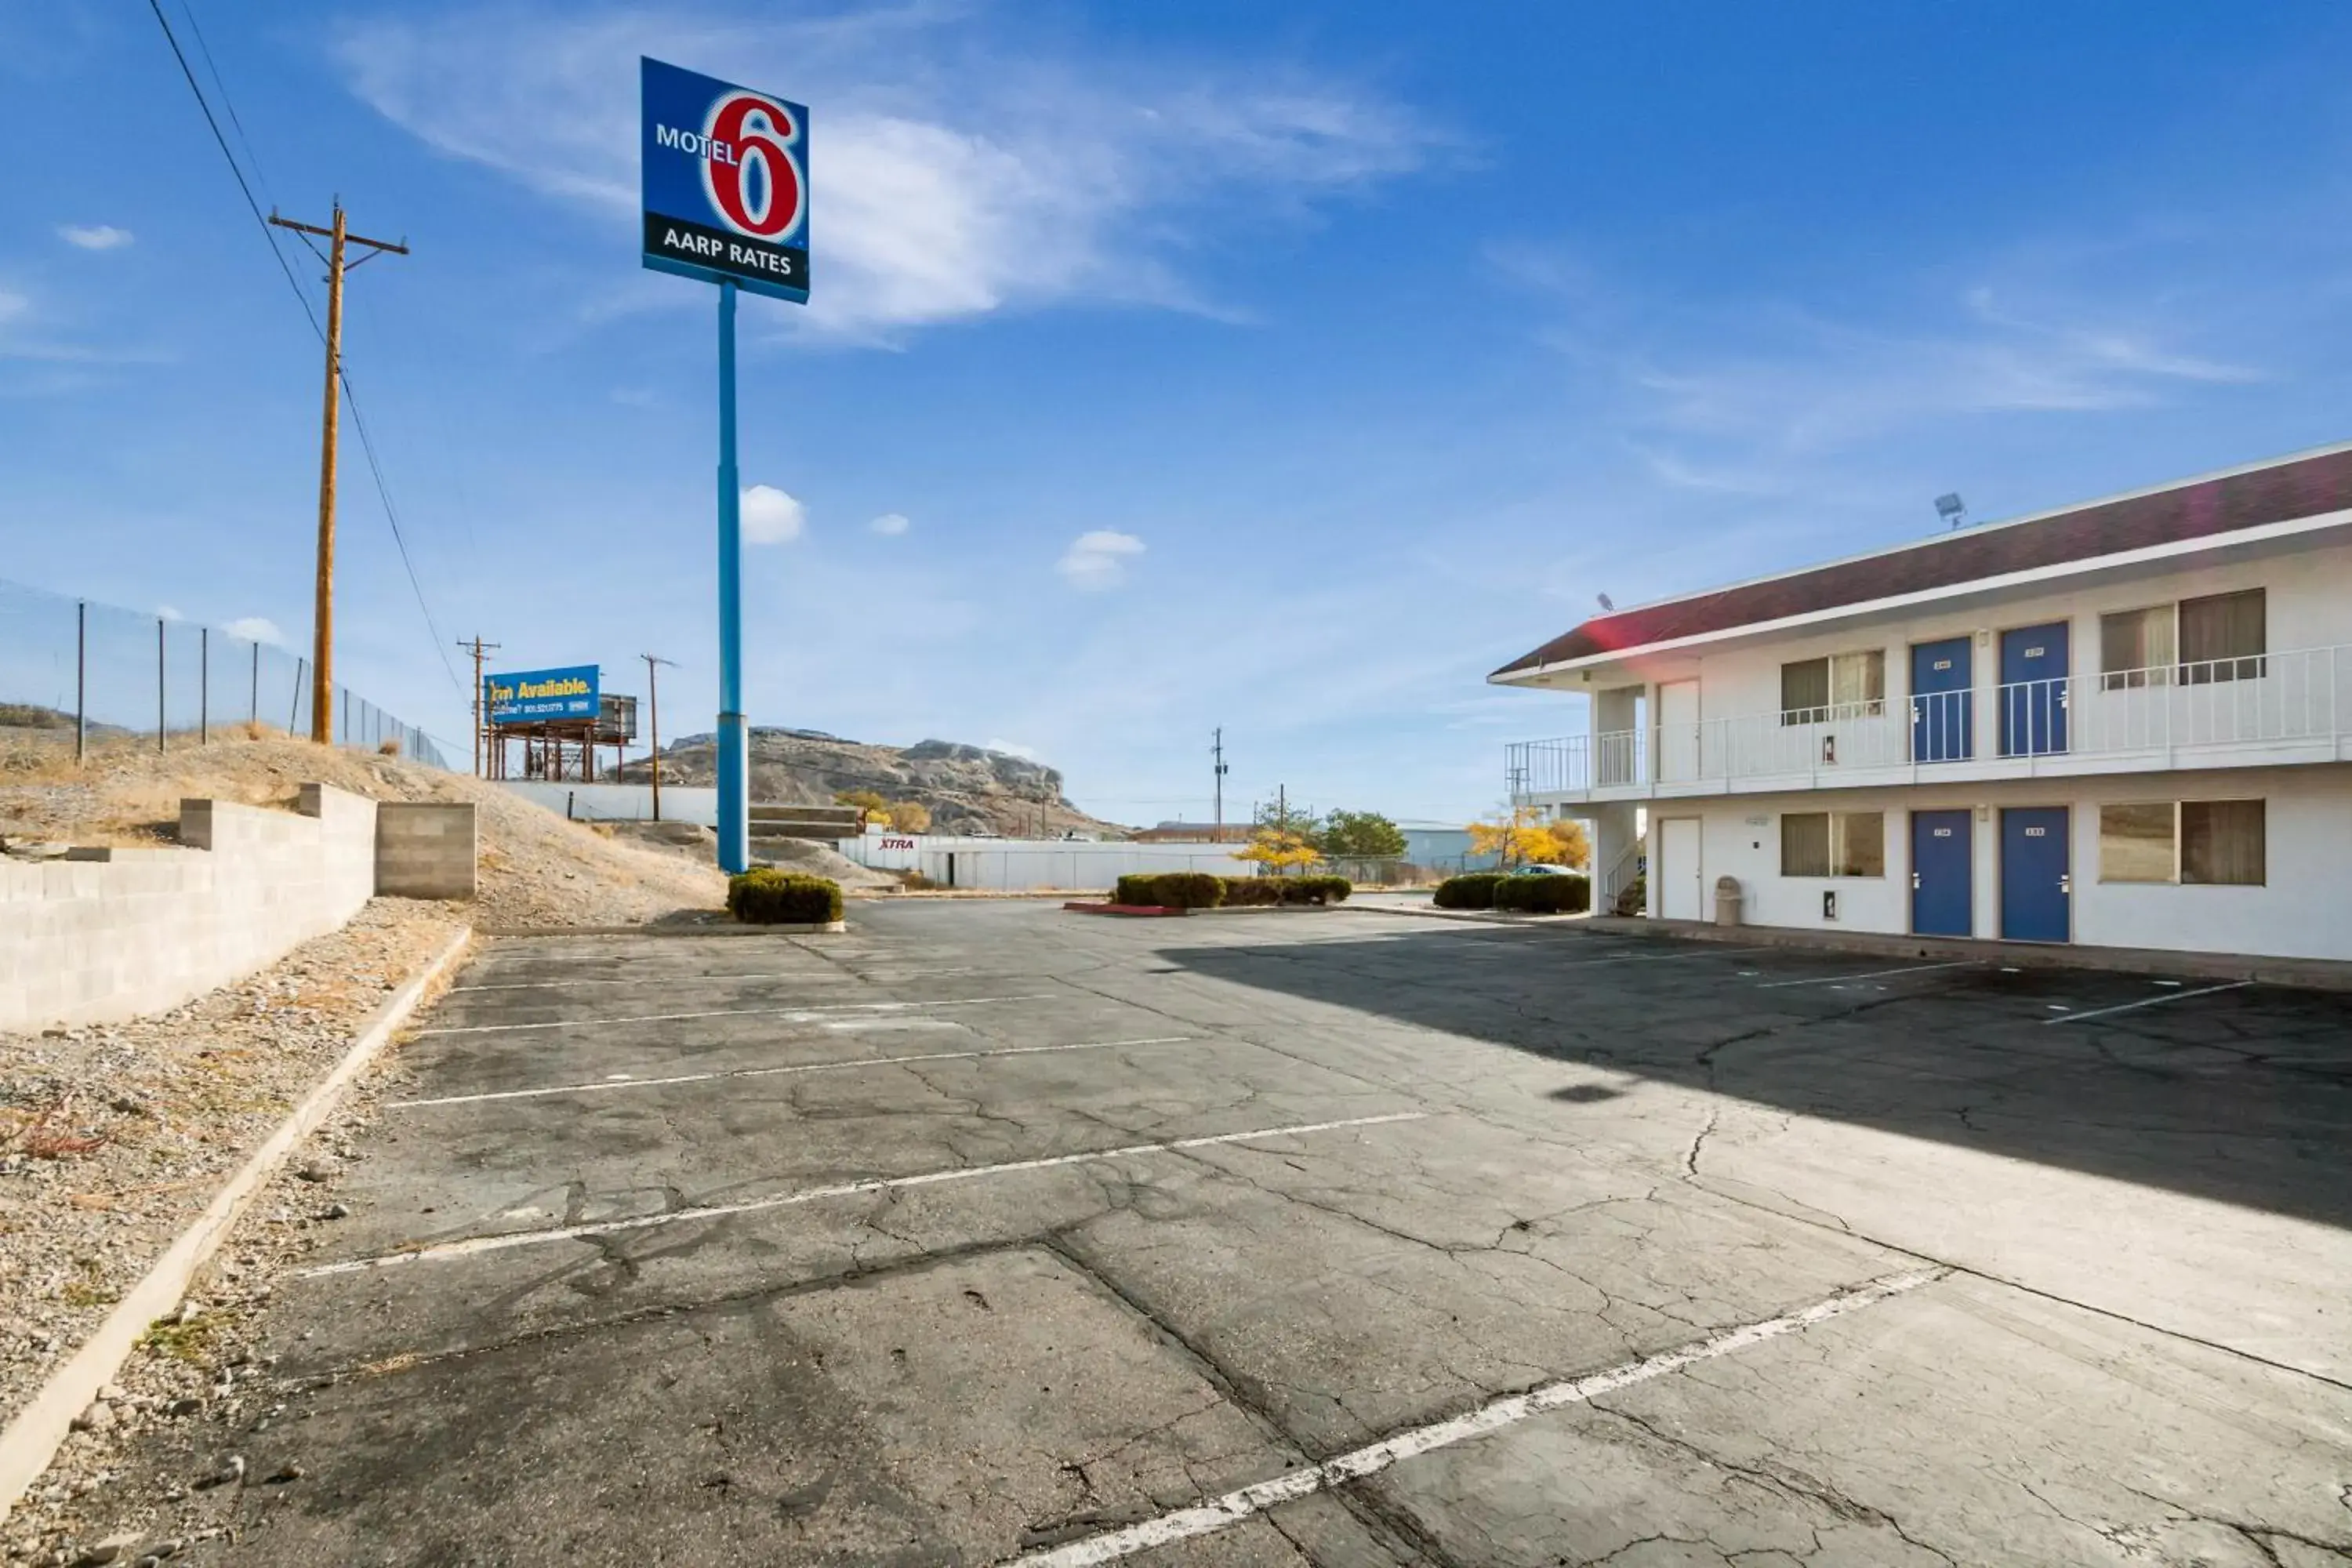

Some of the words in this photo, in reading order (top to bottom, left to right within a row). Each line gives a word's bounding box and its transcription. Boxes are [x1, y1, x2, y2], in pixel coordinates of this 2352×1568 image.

[656, 124, 740, 166] MOTEL
[708, 95, 800, 237] 6
[664, 228, 724, 258] AARP
[730, 244, 792, 275] RATES
[519, 678, 590, 699] Available.
[878, 838, 913, 850] XTRA
